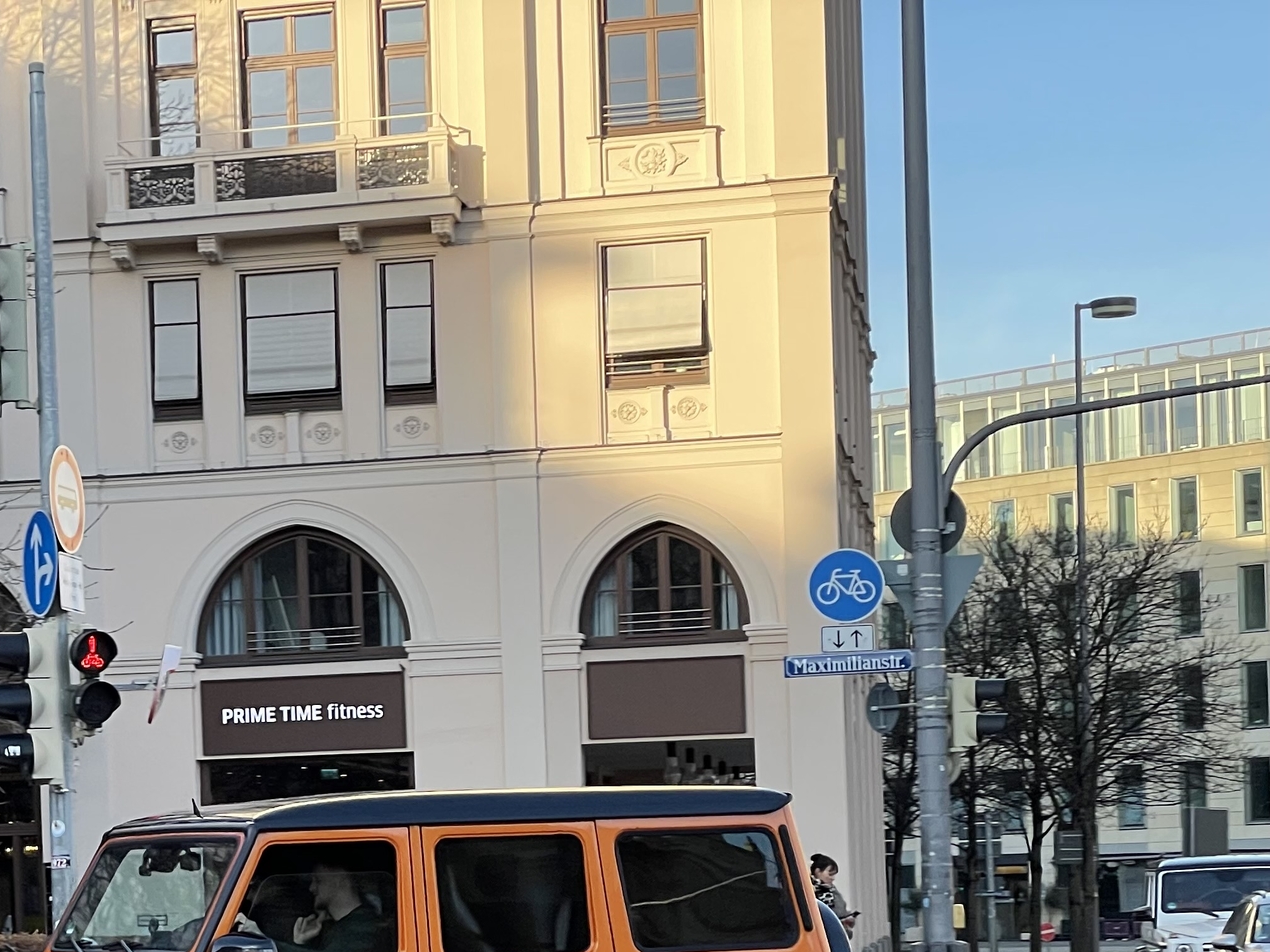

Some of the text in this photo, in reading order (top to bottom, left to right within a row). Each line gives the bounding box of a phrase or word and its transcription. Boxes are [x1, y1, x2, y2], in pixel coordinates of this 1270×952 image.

[793, 655, 906, 675] Maximilianstr.
[222, 702, 384, 724] PRIME TIME fitness
